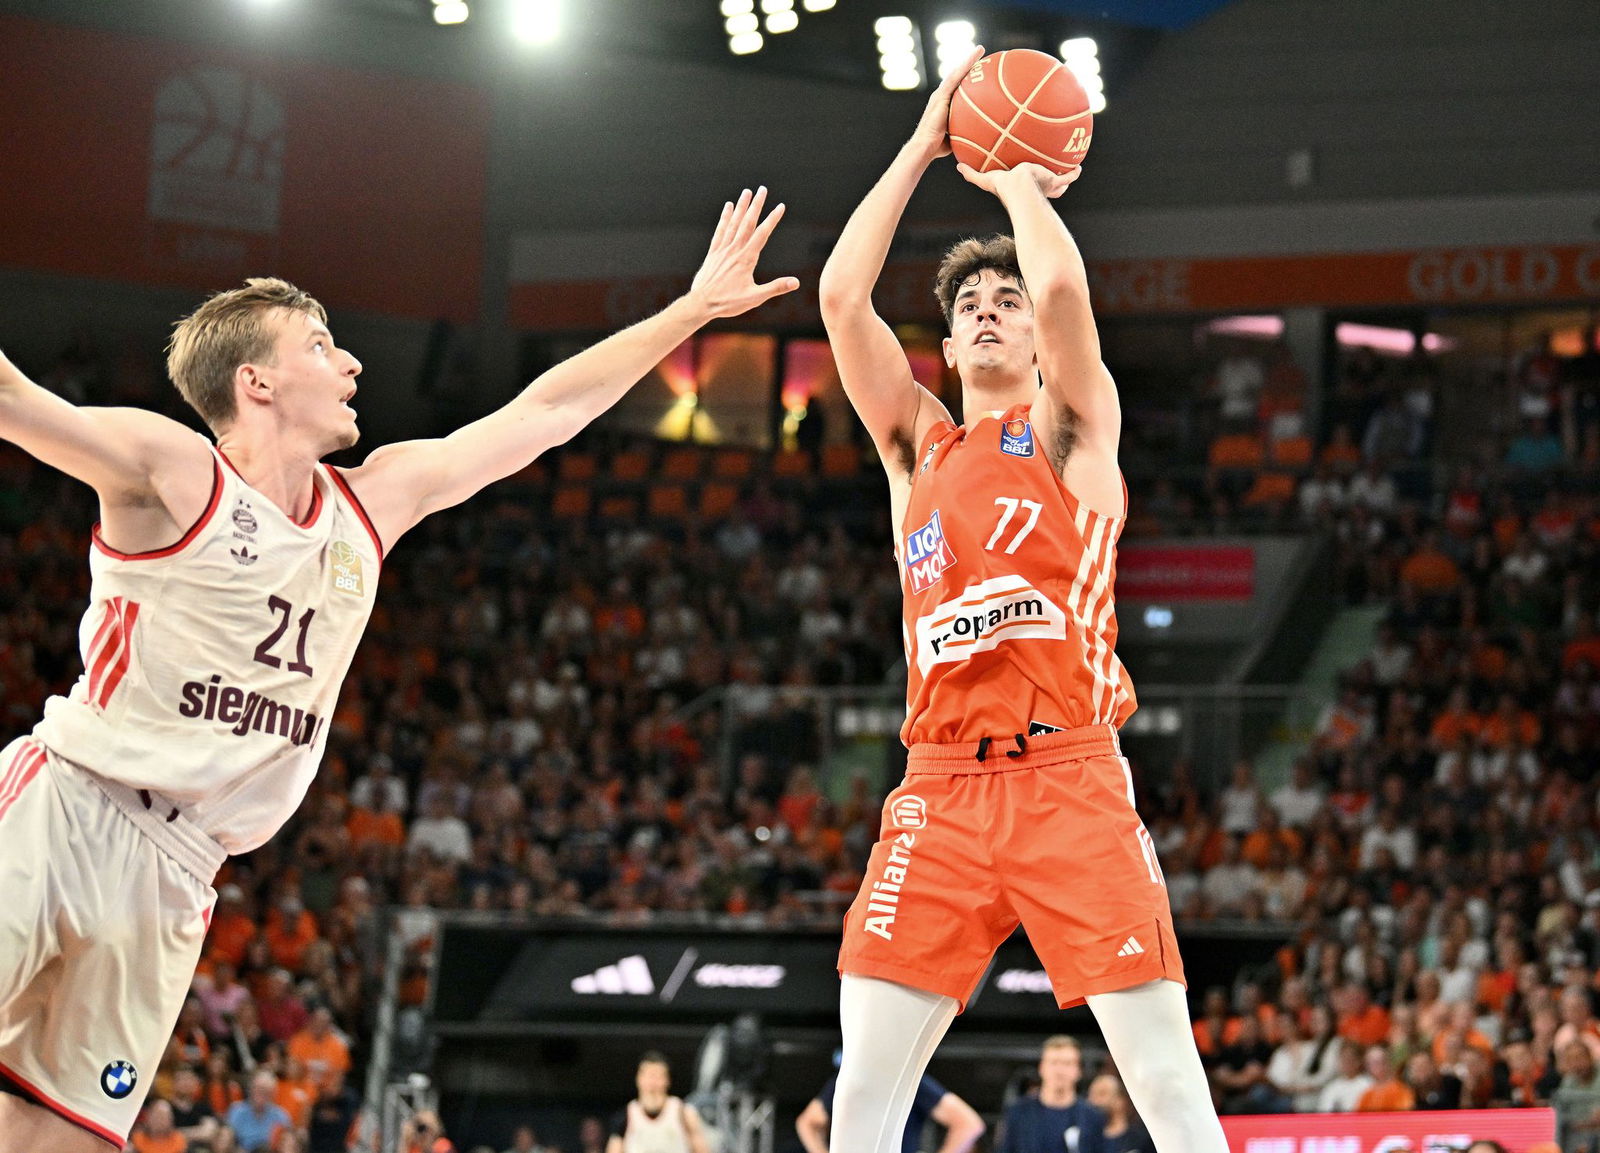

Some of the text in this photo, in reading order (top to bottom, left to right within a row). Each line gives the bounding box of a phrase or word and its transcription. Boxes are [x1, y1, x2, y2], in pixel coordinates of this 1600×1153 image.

[1408, 248, 1558, 300] GOLD
[1003, 443, 1030, 454] BBL
[984, 497, 1043, 554] 77
[335, 576, 361, 593] BBL
[253, 595, 315, 678] 21
[864, 832, 916, 941] Allianz
